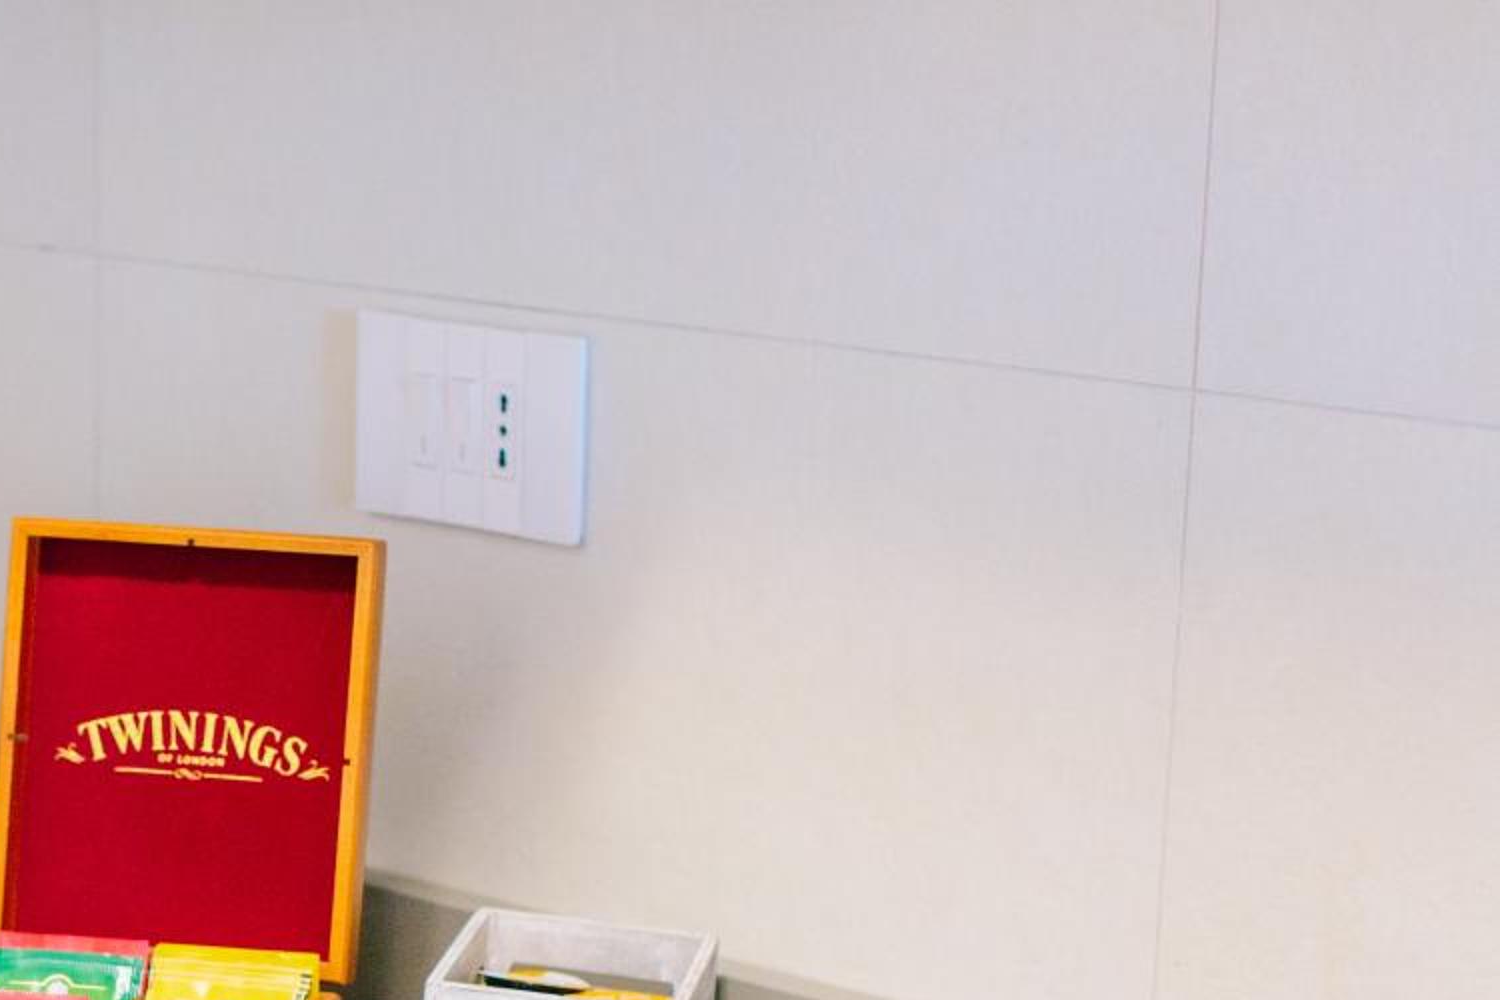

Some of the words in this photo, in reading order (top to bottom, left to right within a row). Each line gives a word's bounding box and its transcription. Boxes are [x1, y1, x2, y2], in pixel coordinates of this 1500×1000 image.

[77, 709, 308, 777] TWININGS
[157, 753, 173, 763] OF
[176, 754, 226, 767] LONDON
